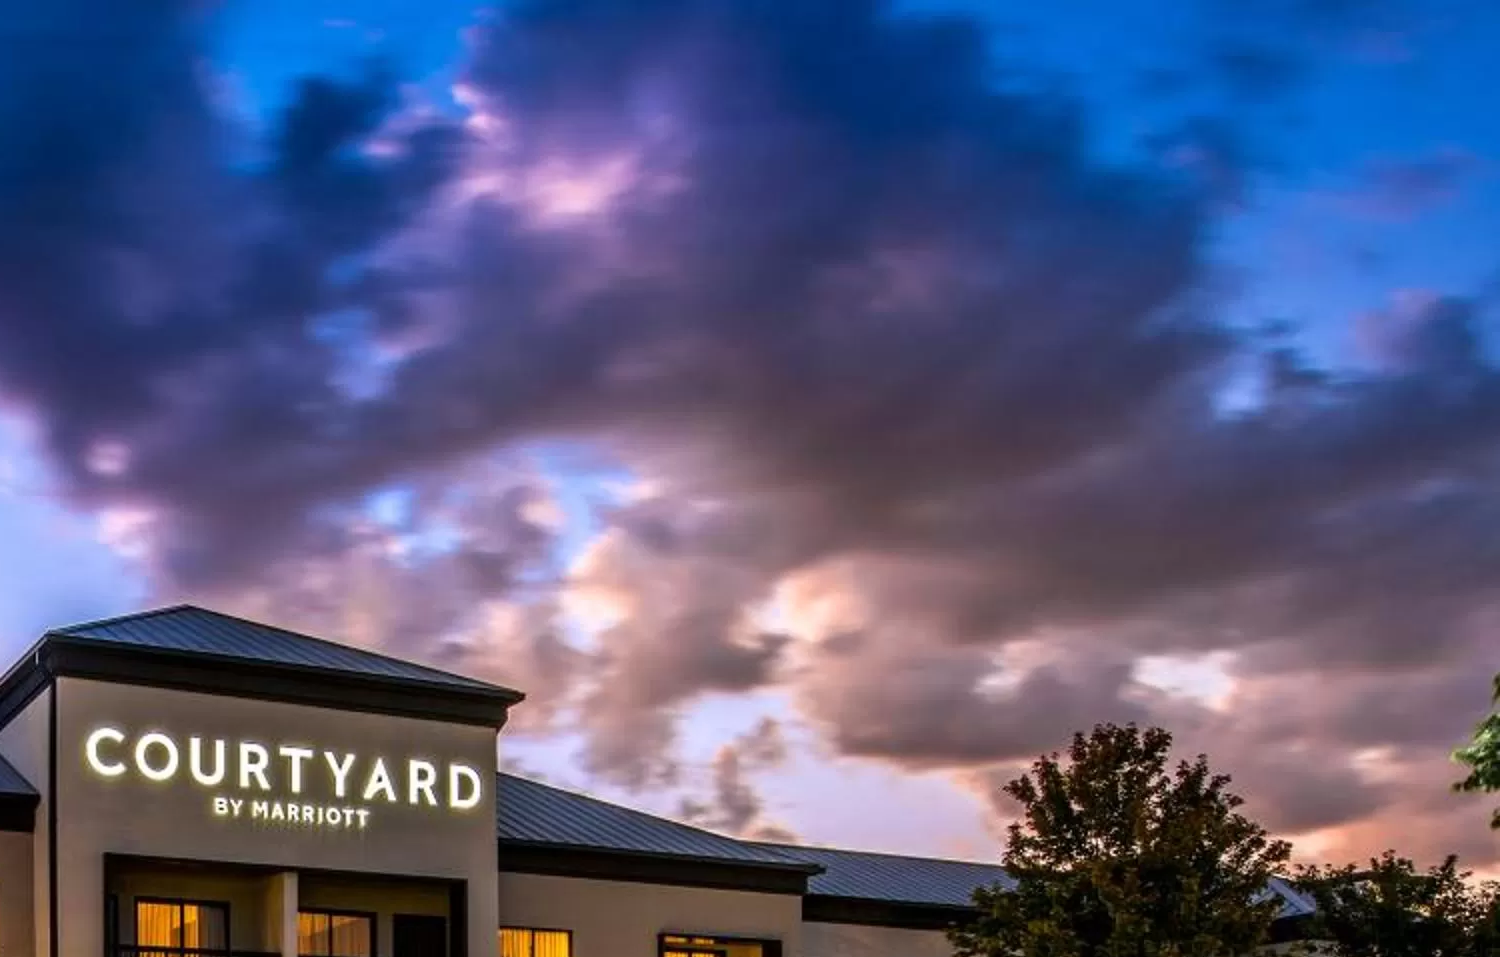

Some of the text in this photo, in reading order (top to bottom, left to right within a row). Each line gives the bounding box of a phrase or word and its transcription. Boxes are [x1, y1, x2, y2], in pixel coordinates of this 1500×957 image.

[84, 726, 483, 811] COURTYARD
[212, 796, 371, 828] BY MARRIOTT
